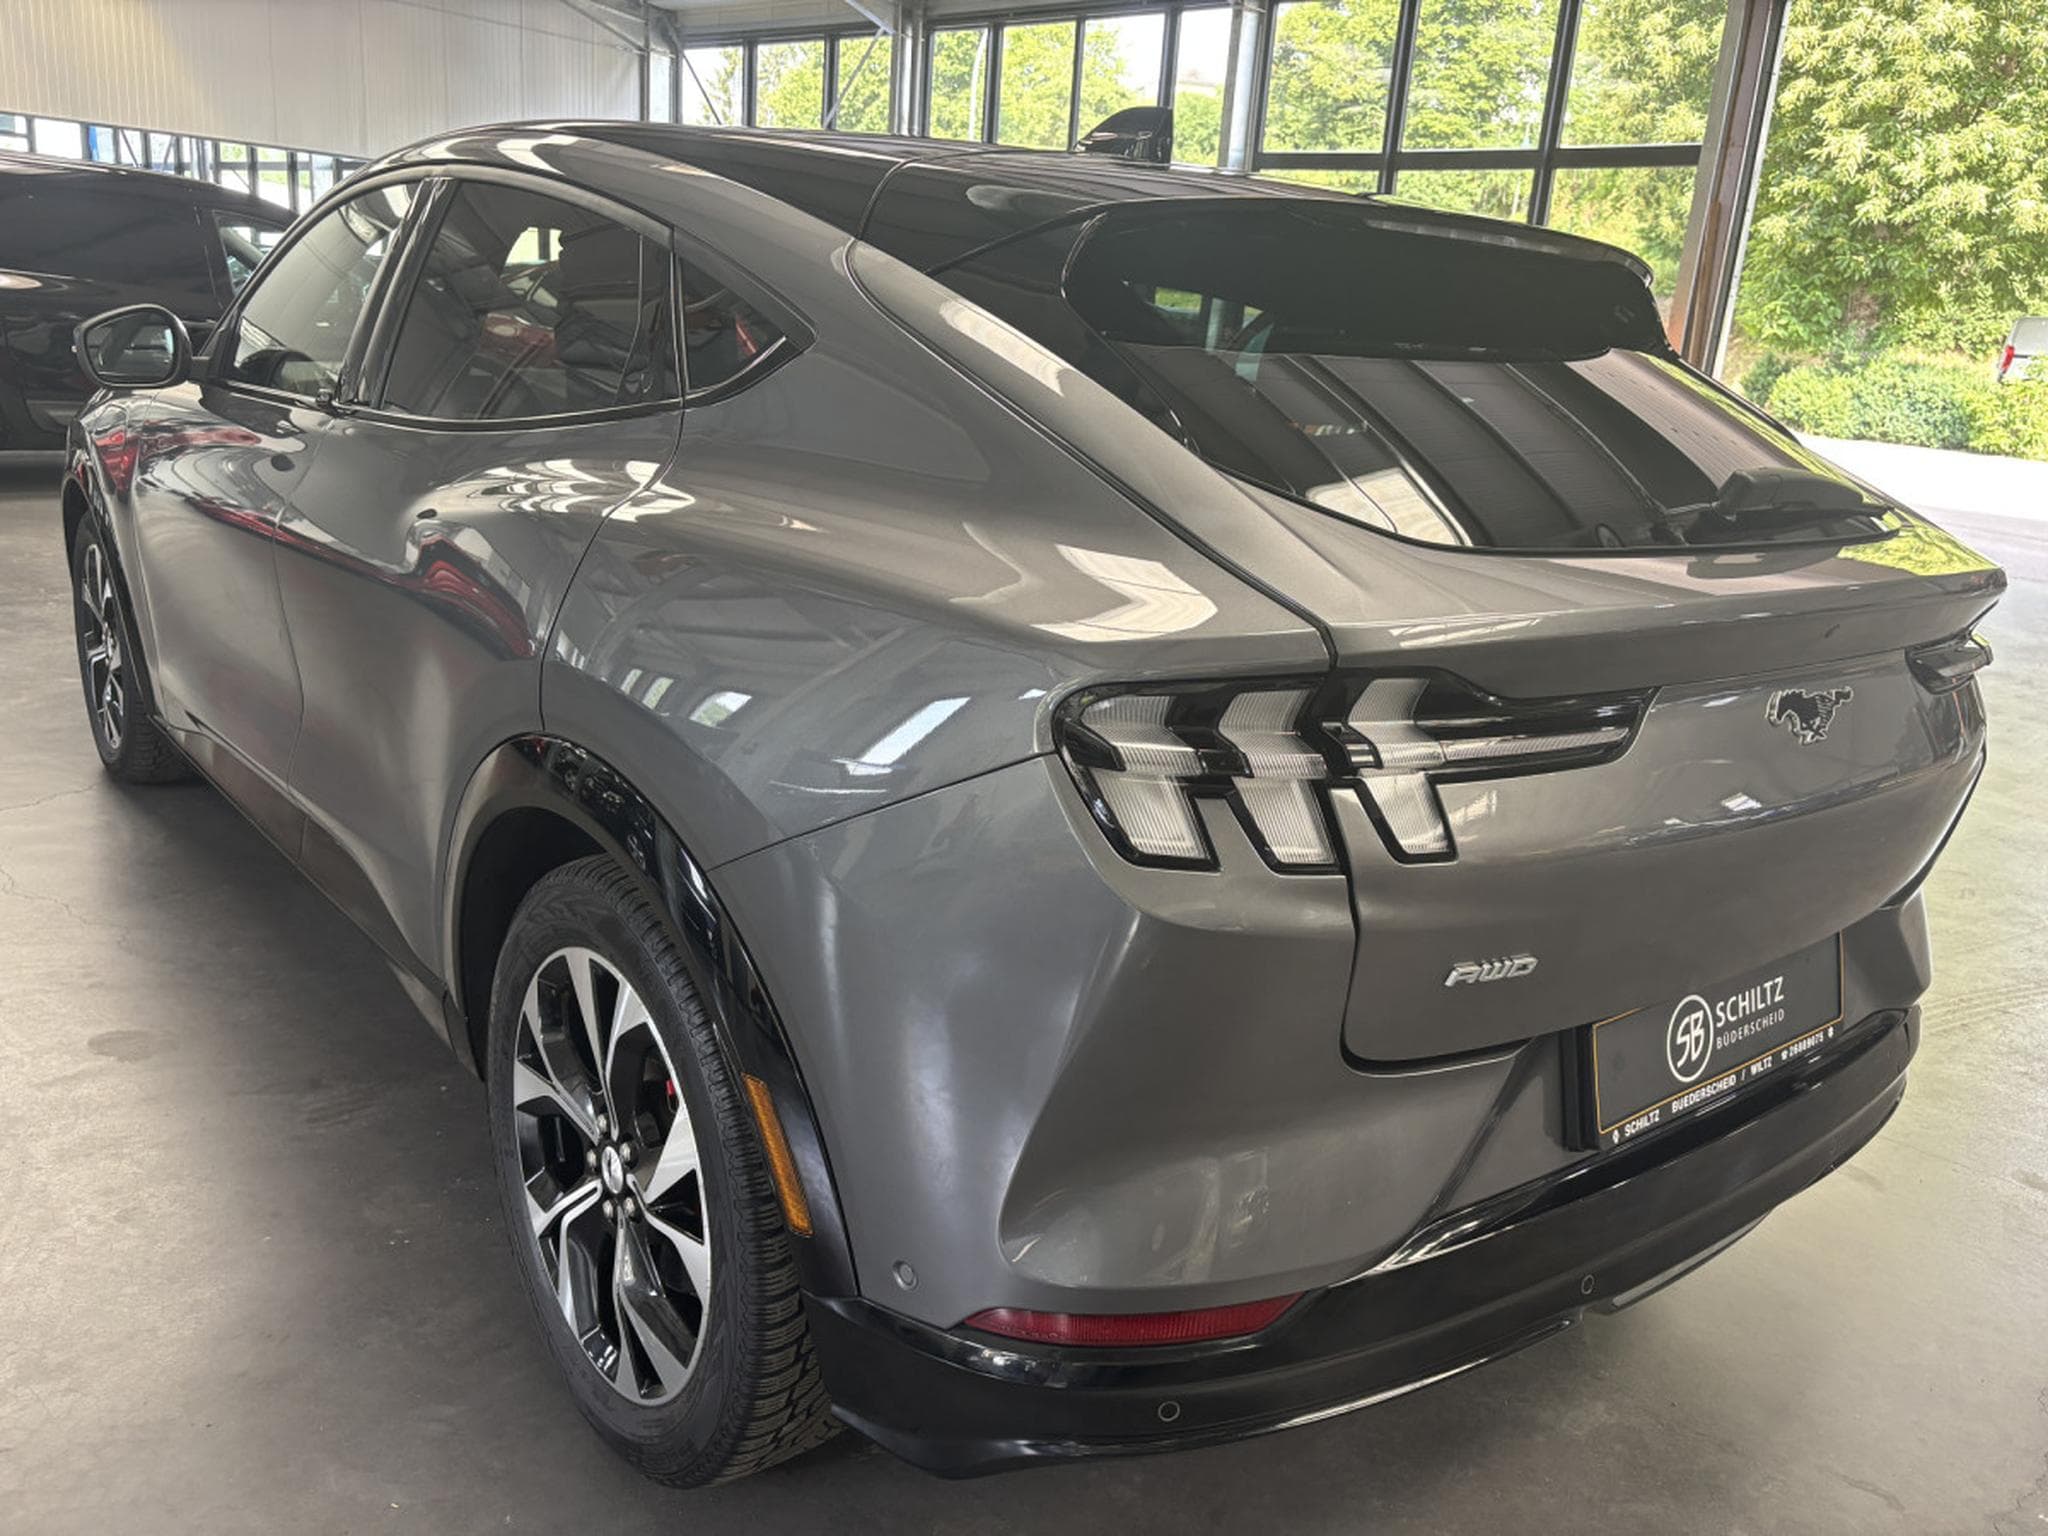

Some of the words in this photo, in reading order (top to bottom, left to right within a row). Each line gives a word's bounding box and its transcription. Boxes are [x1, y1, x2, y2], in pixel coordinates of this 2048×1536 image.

[1444, 954, 1539, 988] AWD
[1715, 976, 1785, 1026] SCHILTZ
[1675, 1008, 1704, 1067] SB
[1716, 1009, 1785, 1050] BÜDERSCHEID
[1624, 1109, 1660, 1137] SCHILTZ
[1671, 1075, 1736, 1113] BUEDERSCHEID
[1750, 1056, 1773, 1076] WILTZ
